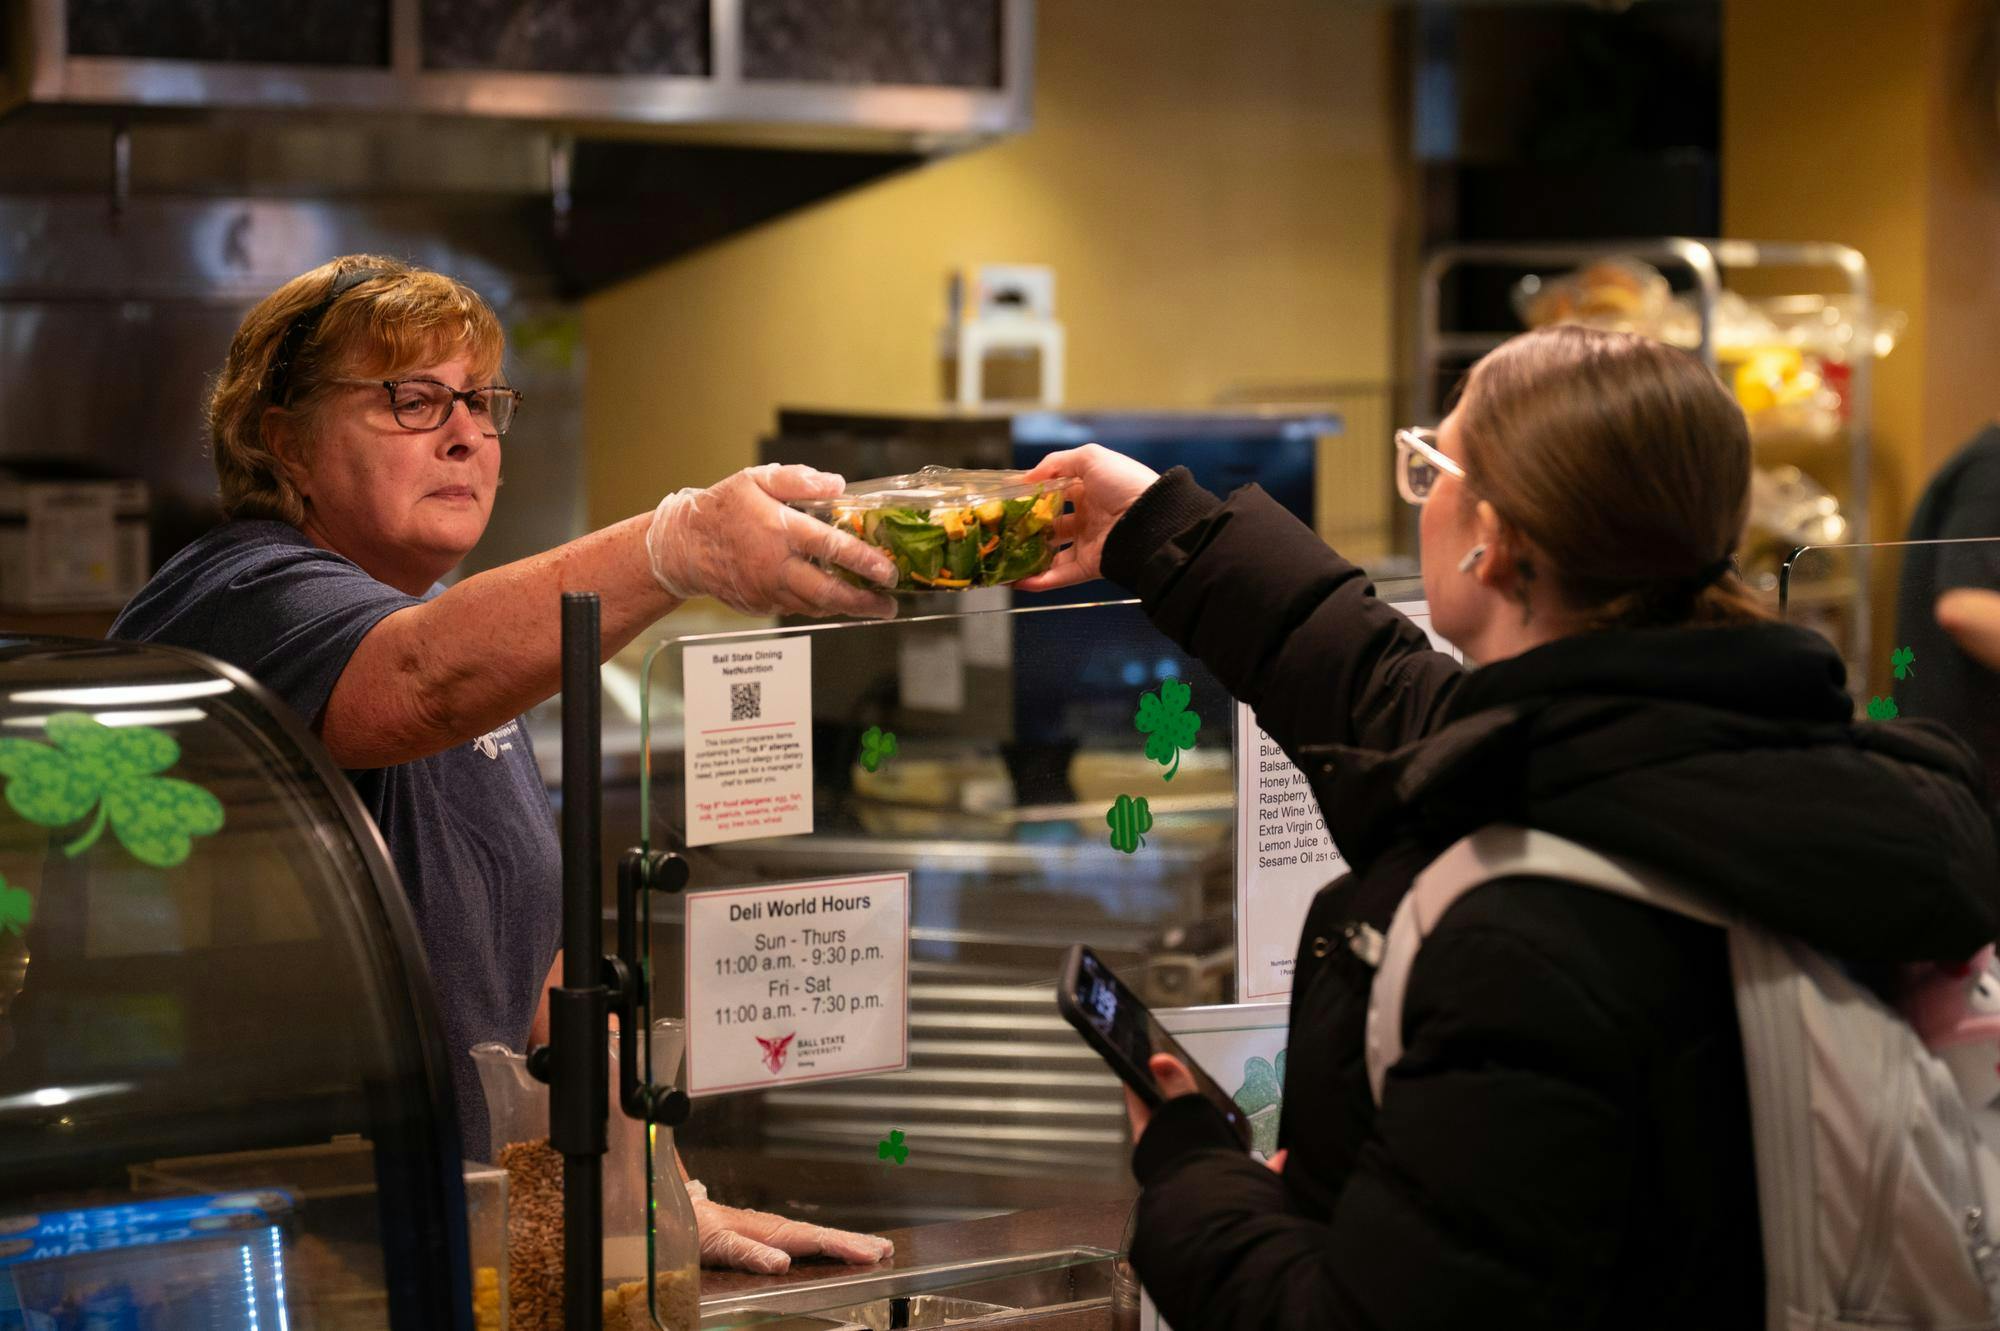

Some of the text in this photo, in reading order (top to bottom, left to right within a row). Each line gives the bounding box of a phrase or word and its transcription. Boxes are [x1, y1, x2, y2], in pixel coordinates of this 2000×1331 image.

[713, 651, 782, 663] Ball State Dining
[723, 665, 773, 675] NetNutrition
[696, 750, 728, 758] containing
[1260, 745, 1281, 756] Blue
[753, 755, 772, 763] allergy
[715, 770, 736, 778] please
[721, 779, 735, 787] chef
[1260, 774, 1308, 788] Honey Mu
[1260, 791, 1307, 804] Raspberry
[1260, 808, 1278, 821] Red
[1281, 806, 1305, 818] Wine
[1259, 825, 1283, 836] Extra
[1286, 820, 1312, 834] Virgin
[1259, 840, 1291, 852] Lemon
[1294, 837, 1318, 848] Juice
[1259, 856, 1297, 868] Sesame
[1300, 852, 1312, 863] Oil
[1316, 854, 1327, 862] 251
[730, 895, 871, 922] Deli World Hours
[755, 934, 786, 951] Sun
[802, 929, 846, 946] Thurs
[715, 955, 757, 975] 11:00
[762, 956, 795, 971] a.m.
[812, 946, 846, 966] 9:30
[851, 945, 884, 966] p.m.
[769, 979, 788, 998] Fri
[804, 976, 831, 994] Sat
[715, 1004, 757, 1025] 11:00
[762, 1005, 796, 1020] a.m.
[812, 995, 845, 1015] 7:30
[851, 994, 884, 1014] p.m.
[798, 1035, 844, 1048] BALL STATE
[798, 1046, 841, 1057] UNIVERSITY
